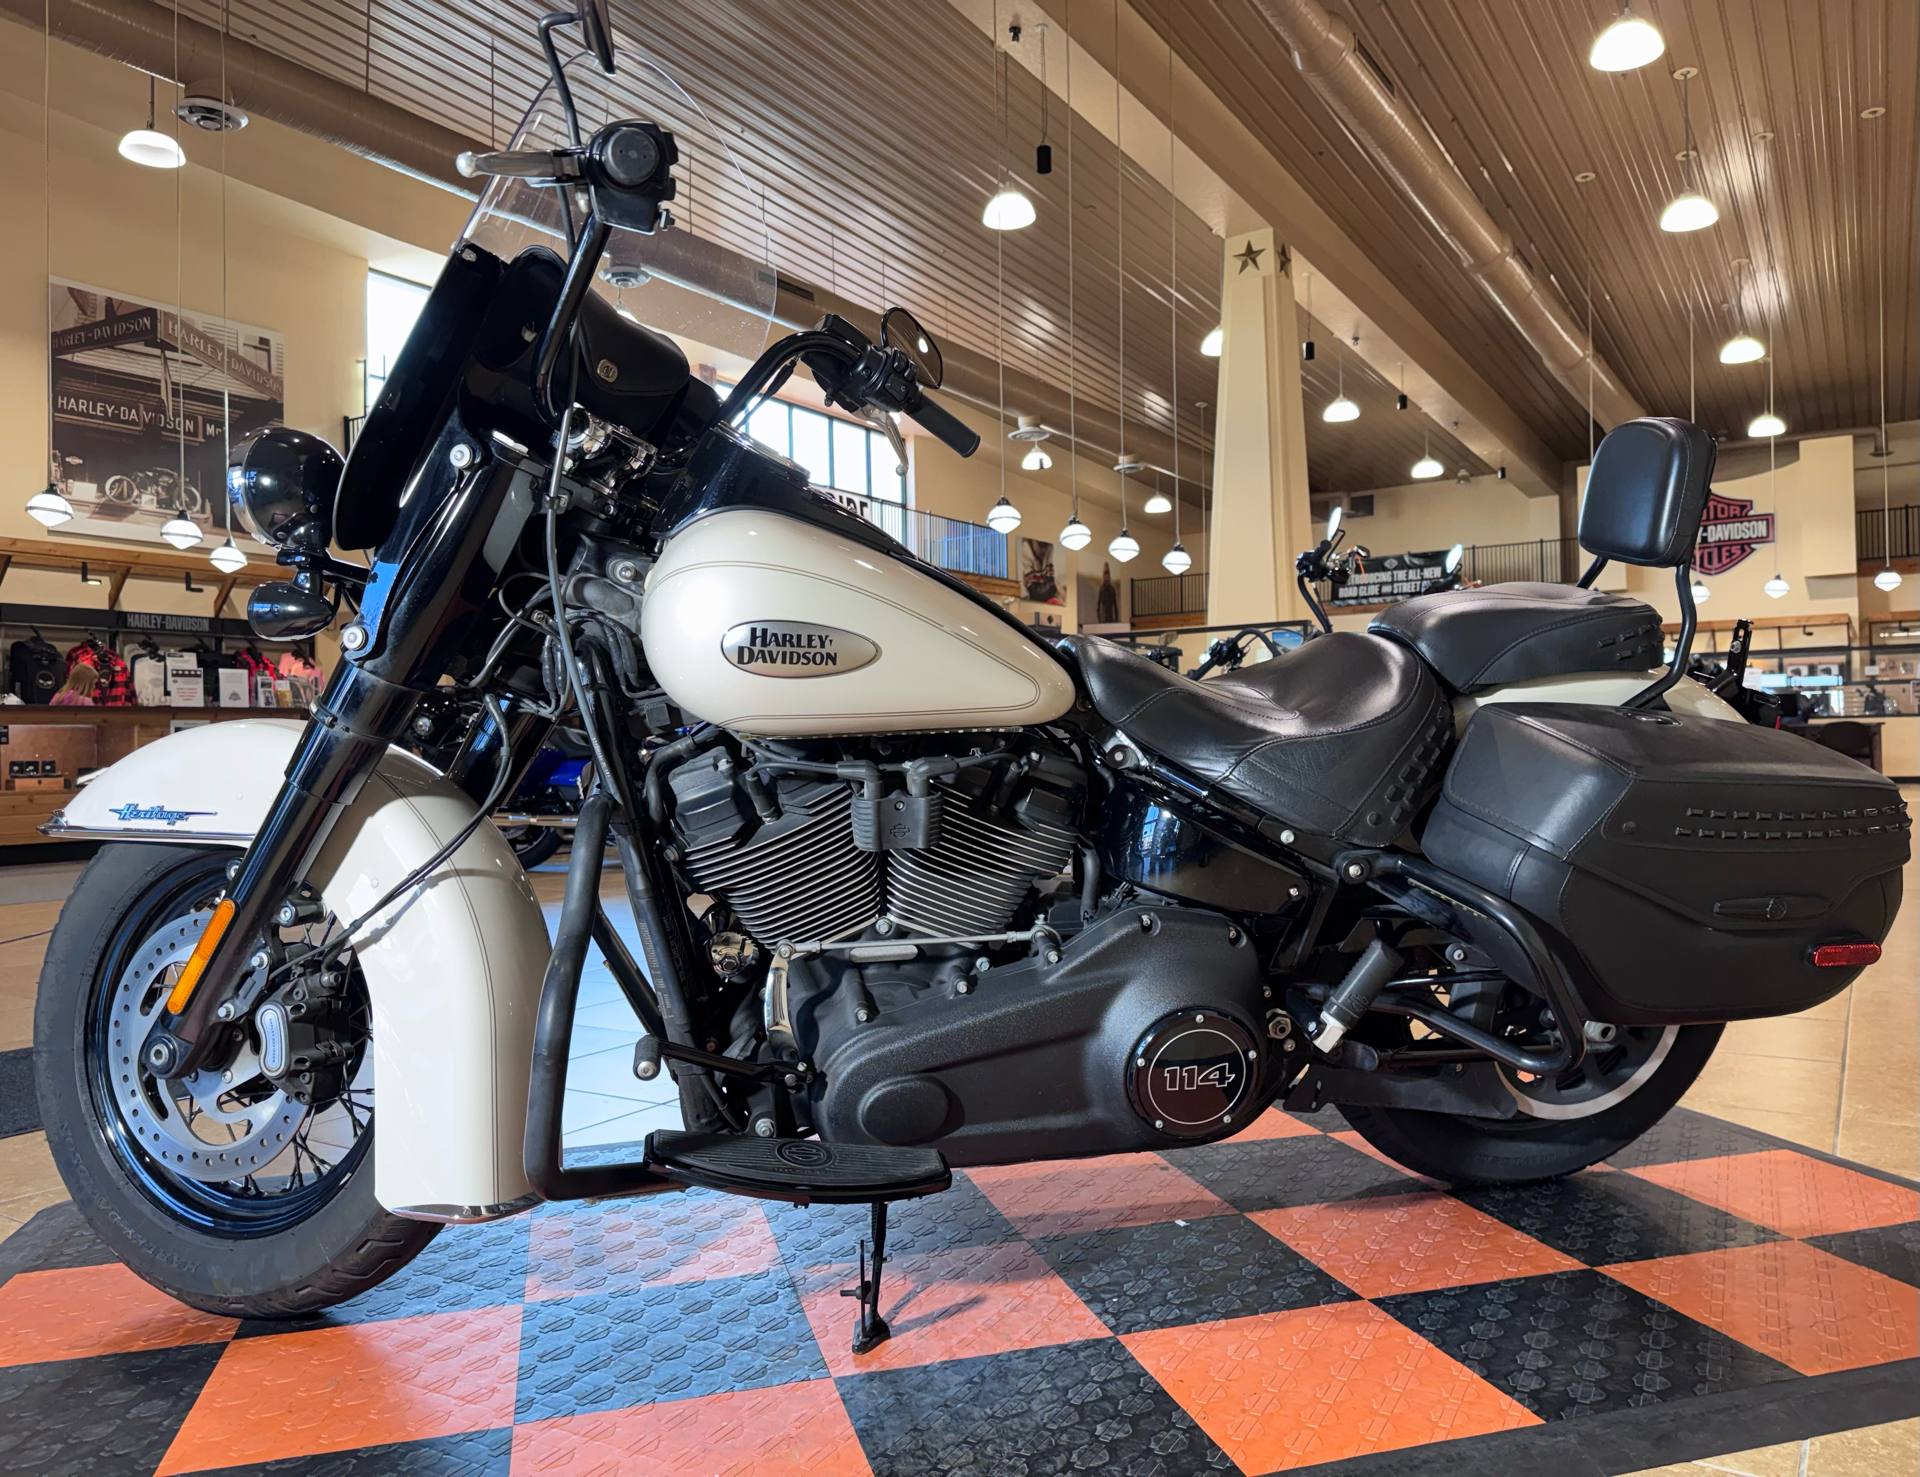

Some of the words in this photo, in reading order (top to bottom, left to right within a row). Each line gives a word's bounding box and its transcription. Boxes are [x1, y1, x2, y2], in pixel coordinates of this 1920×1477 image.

[52, 315, 152, 349] HARLEY-DAVIDSON
[168, 319, 283, 394] HARLEY-DAVIDSON
[57, 394, 194, 434] HARLEY-DAVIDSON
[1701, 500, 1741, 521] TOR
[1697, 519, 1768, 543] Y-DAVIDSON
[1346, 571, 1393, 586] TRODUCING
[1393, 570, 1408, 581] THE
[1408, 566, 1443, 580] ALL-NEW
[1338, 587, 1358, 598] ROAD
[1359, 585, 1380, 597] GLIDE
[1393, 581, 1422, 594] STREET
[126, 613, 210, 632] HARLEY-DAVIDSON
[737, 645, 838, 666] DAVIDSON
[117, 803, 190, 827] Heritage
[1164, 1062, 1236, 1091] 114
